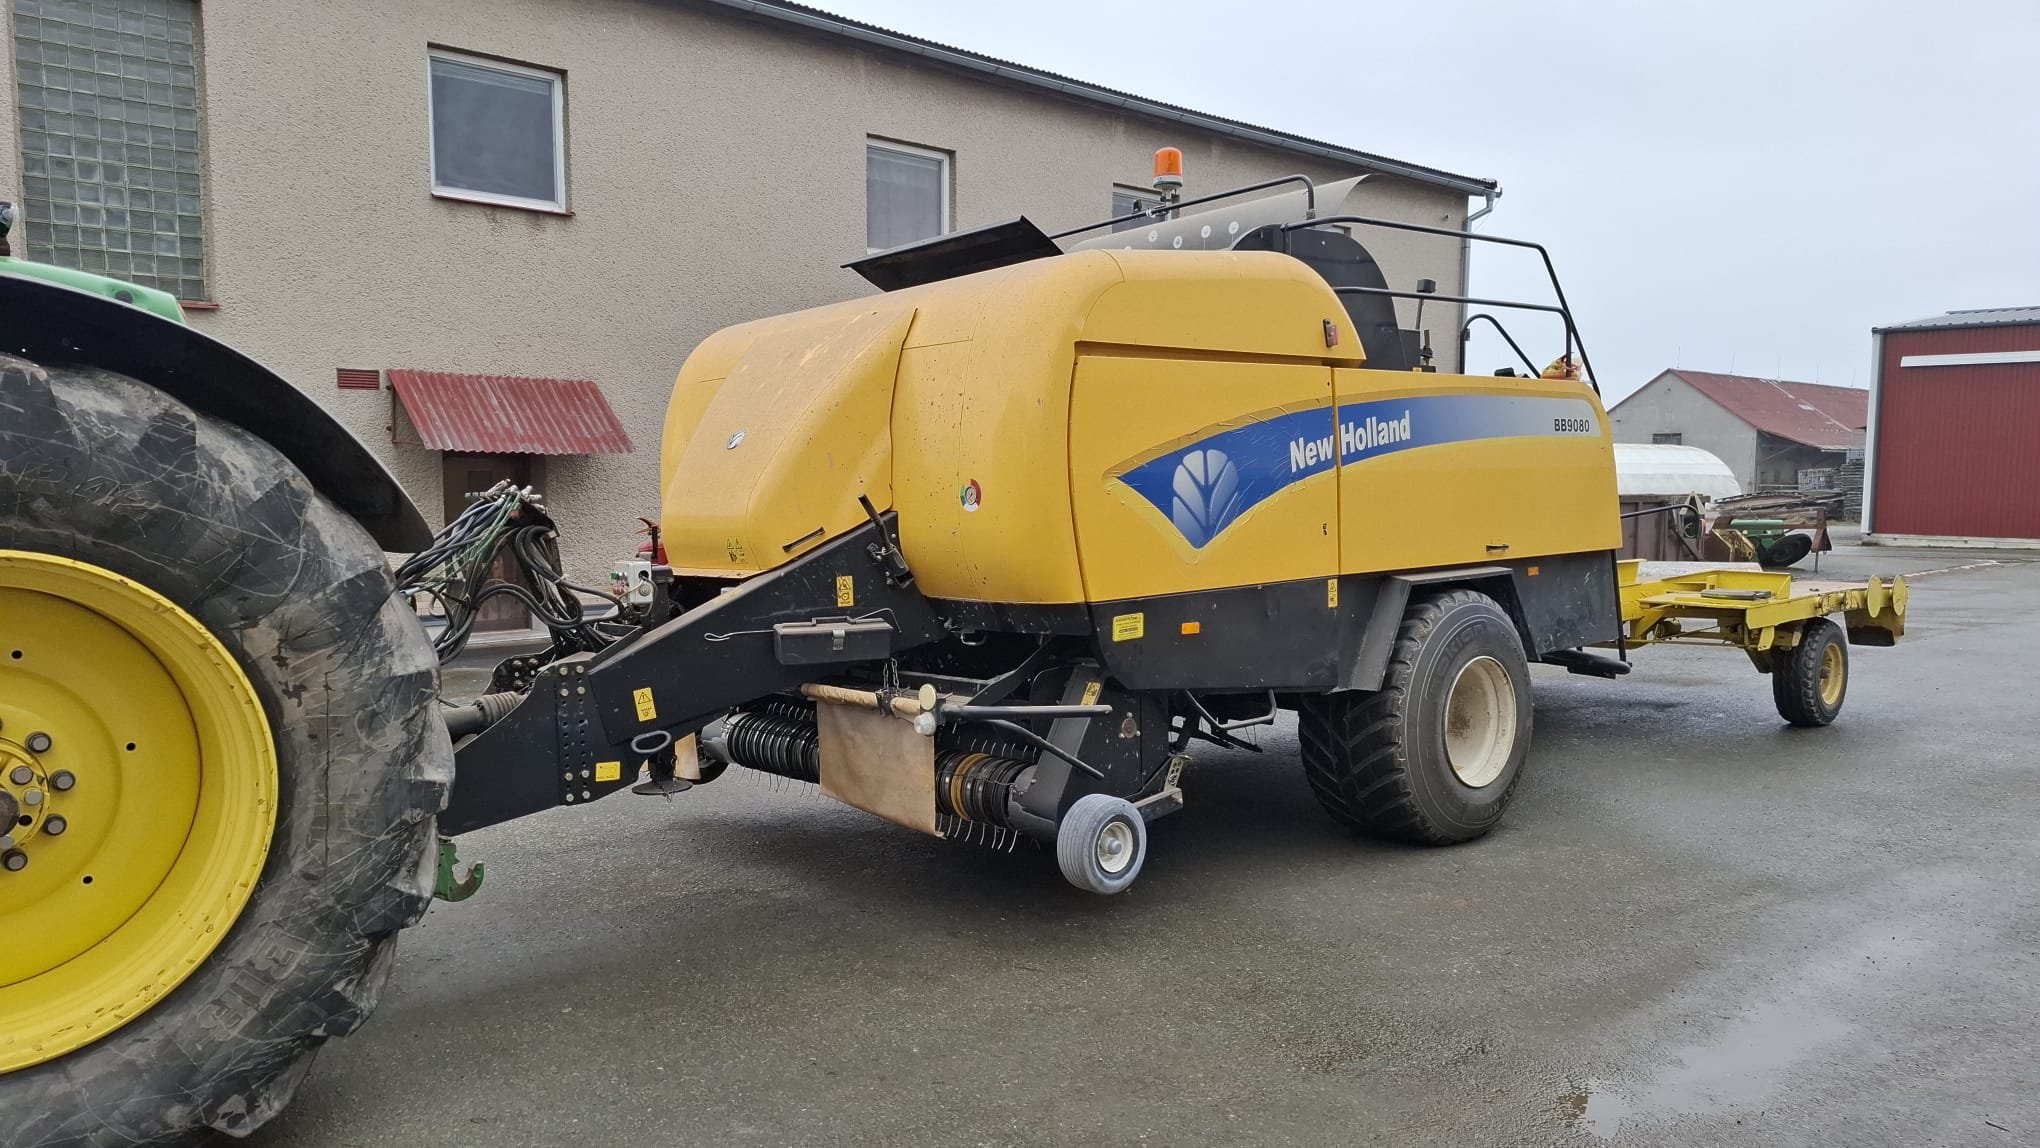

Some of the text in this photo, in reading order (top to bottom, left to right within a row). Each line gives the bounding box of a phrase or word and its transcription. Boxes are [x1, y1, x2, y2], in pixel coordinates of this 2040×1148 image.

[1290, 410, 1411, 472] New Holland
[1554, 418, 1590, 432] BB9080
